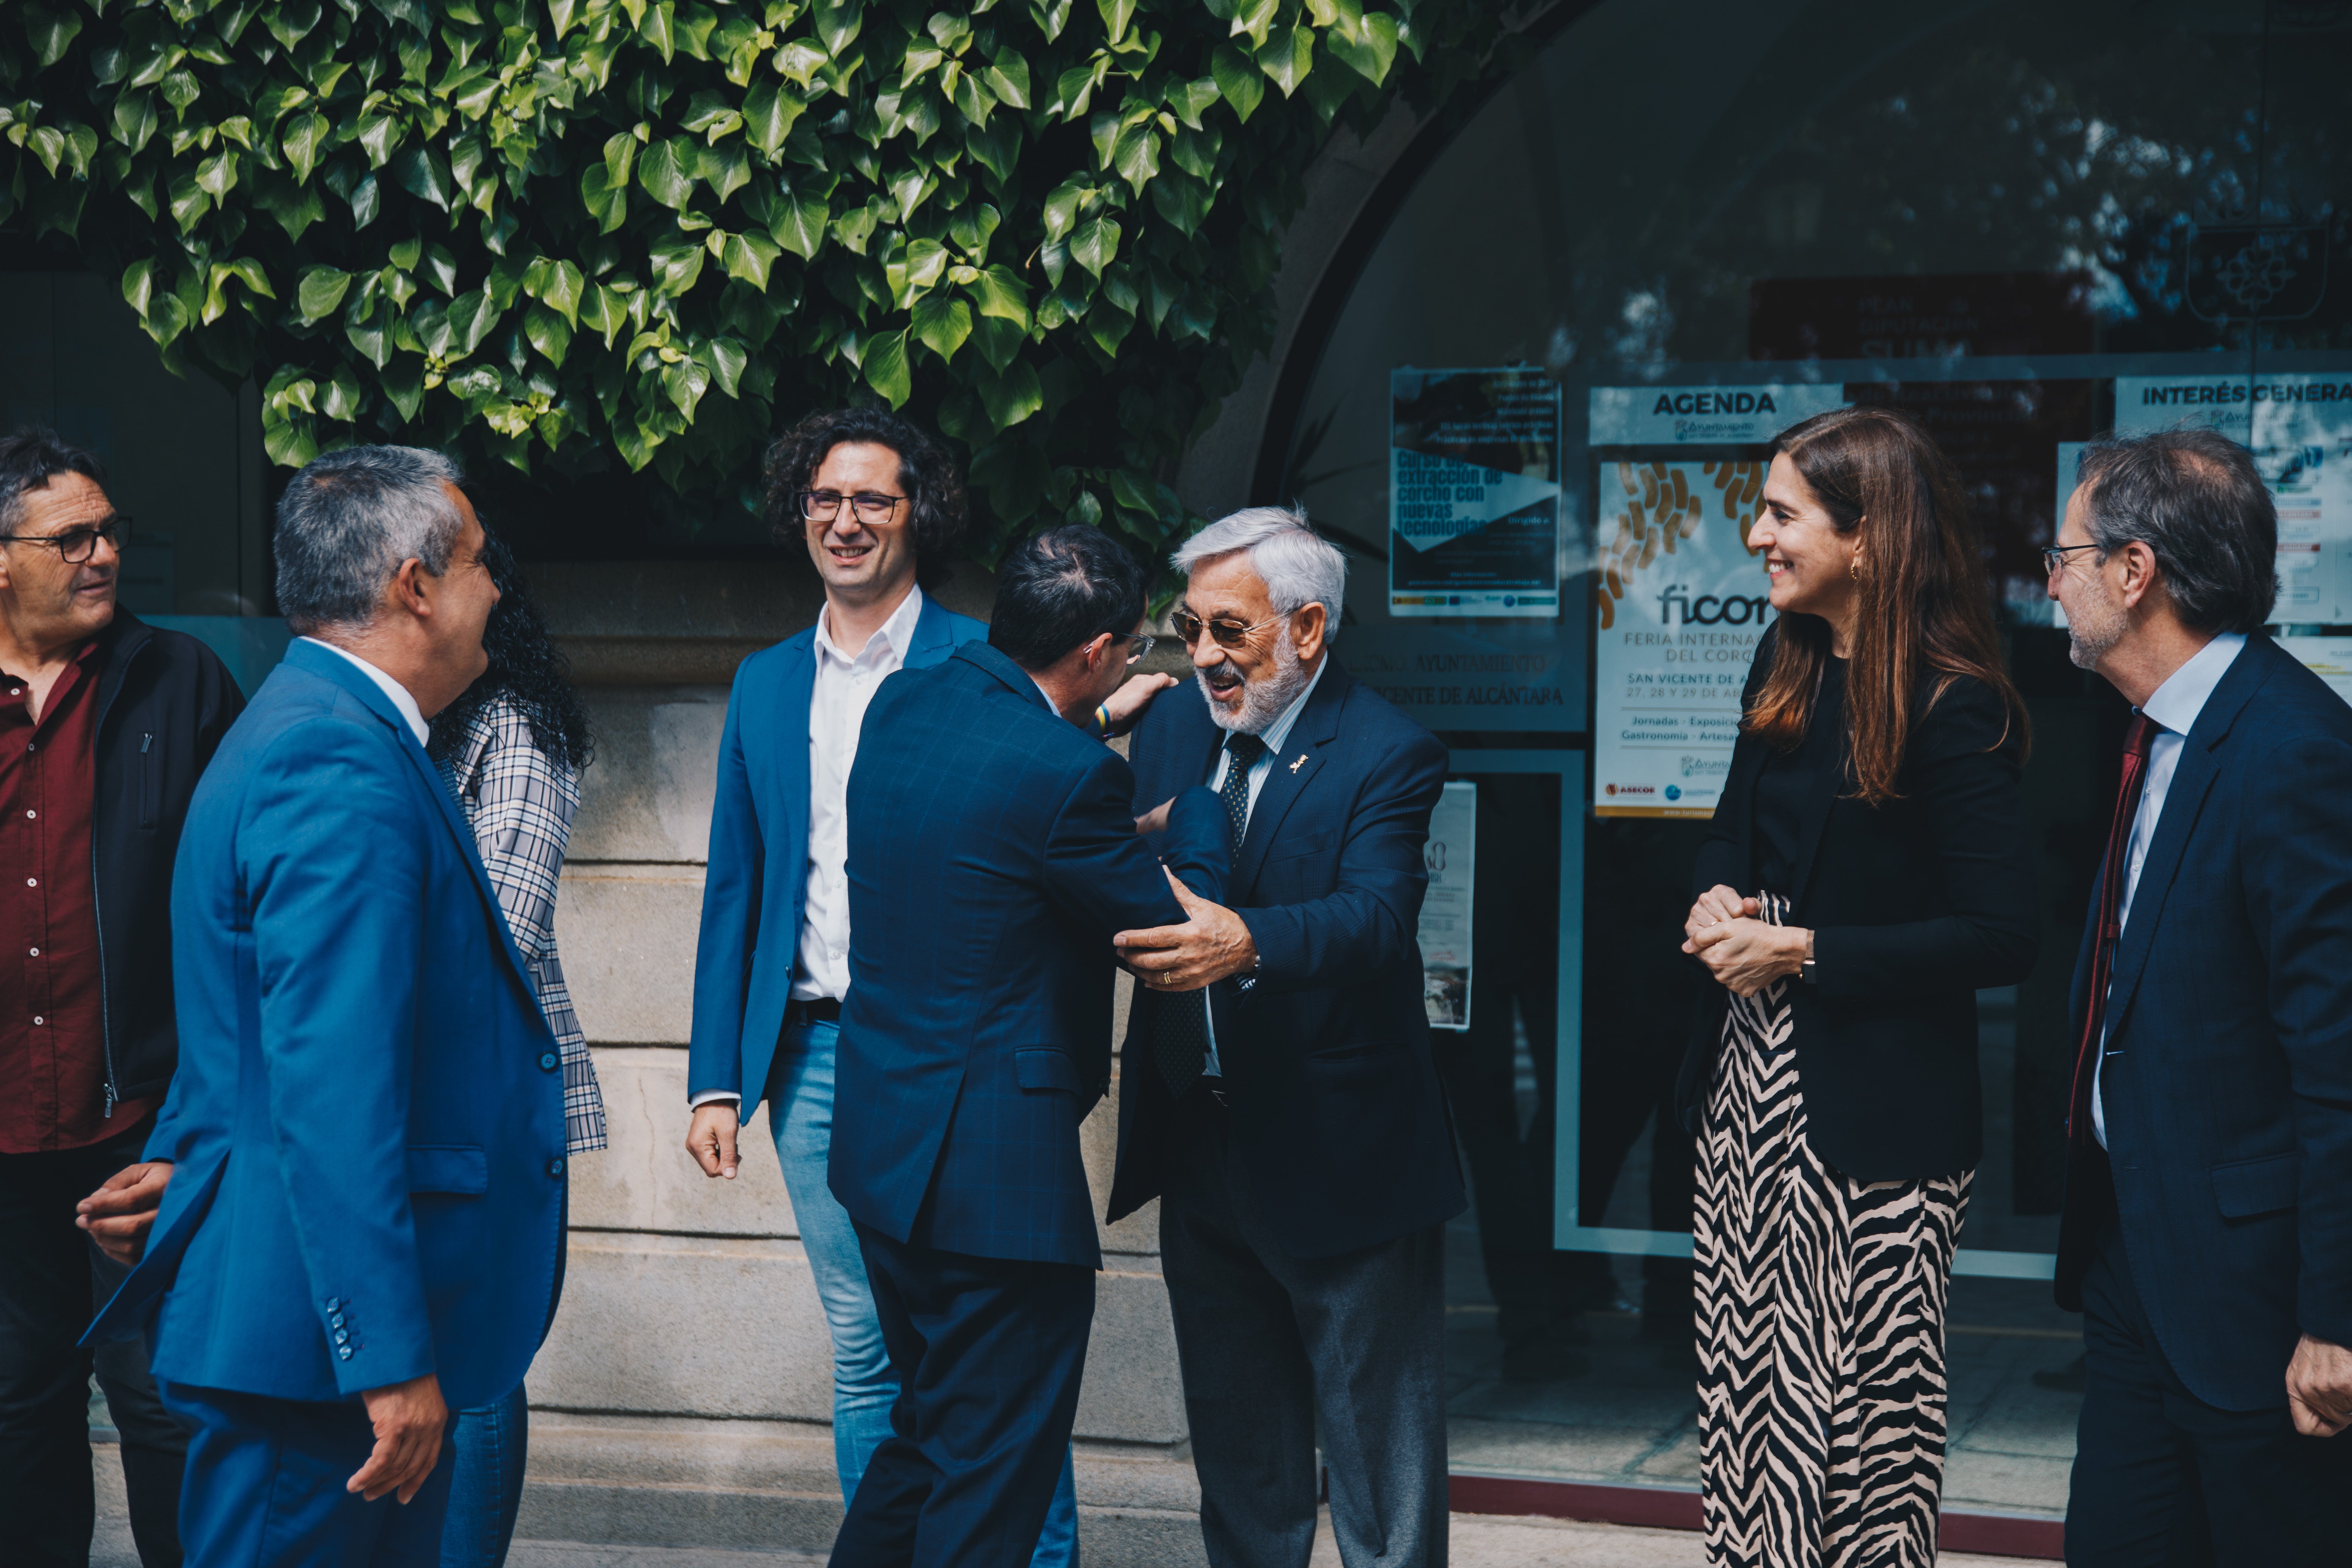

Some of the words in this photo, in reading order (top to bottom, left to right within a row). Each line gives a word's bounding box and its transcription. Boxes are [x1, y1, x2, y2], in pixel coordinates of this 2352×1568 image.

[2143, 381, 2247, 404] INTERÉS
[2251, 383, 2352, 402] GENERA
[1654, 392, 1777, 414] AGENDA
[1688, 422, 1755, 432] AYUNTAMIENTO
[1398, 450, 1441, 469] Curso
[1398, 466, 1480, 485] extracción
[1484, 466, 1502, 485] de
[1398, 482, 1451, 502] corcho
[1455, 485, 1484, 502] con
[1398, 503, 1453, 519] nuevas
[1398, 516, 1488, 536] tecnologías
[1508, 517, 1542, 526] Dirigido
[1625, 633, 1673, 646] FERIA
[1415, 654, 1546, 672] AYUNTAMIENTO
[1666, 649, 1698, 663] DEL
[1705, 649, 1752, 663] CORC
[1628, 673, 1654, 684] SAN
[1658, 674, 1713, 685] VICENTE
[1718, 674, 1735, 685] DE
[1740, 674, 1748, 684] A
[1373, 686, 1435, 704] ICENTE
[1439, 686, 1462, 705] DE
[1465, 681, 1564, 705] ALCÁNTARA
[1627, 688, 1646, 698] 27,
[1650, 688, 1665, 698] 28
[1670, 688, 1678, 697] Y
[1683, 688, 1697, 698] 29
[1702, 688, 1718, 698] DE
[1724, 688, 1740, 698] AB
[1632, 716, 1679, 726] Jornadas
[1622, 730, 1689, 741] Gastronomía
[1695, 758, 1731, 768] AYUNTA
